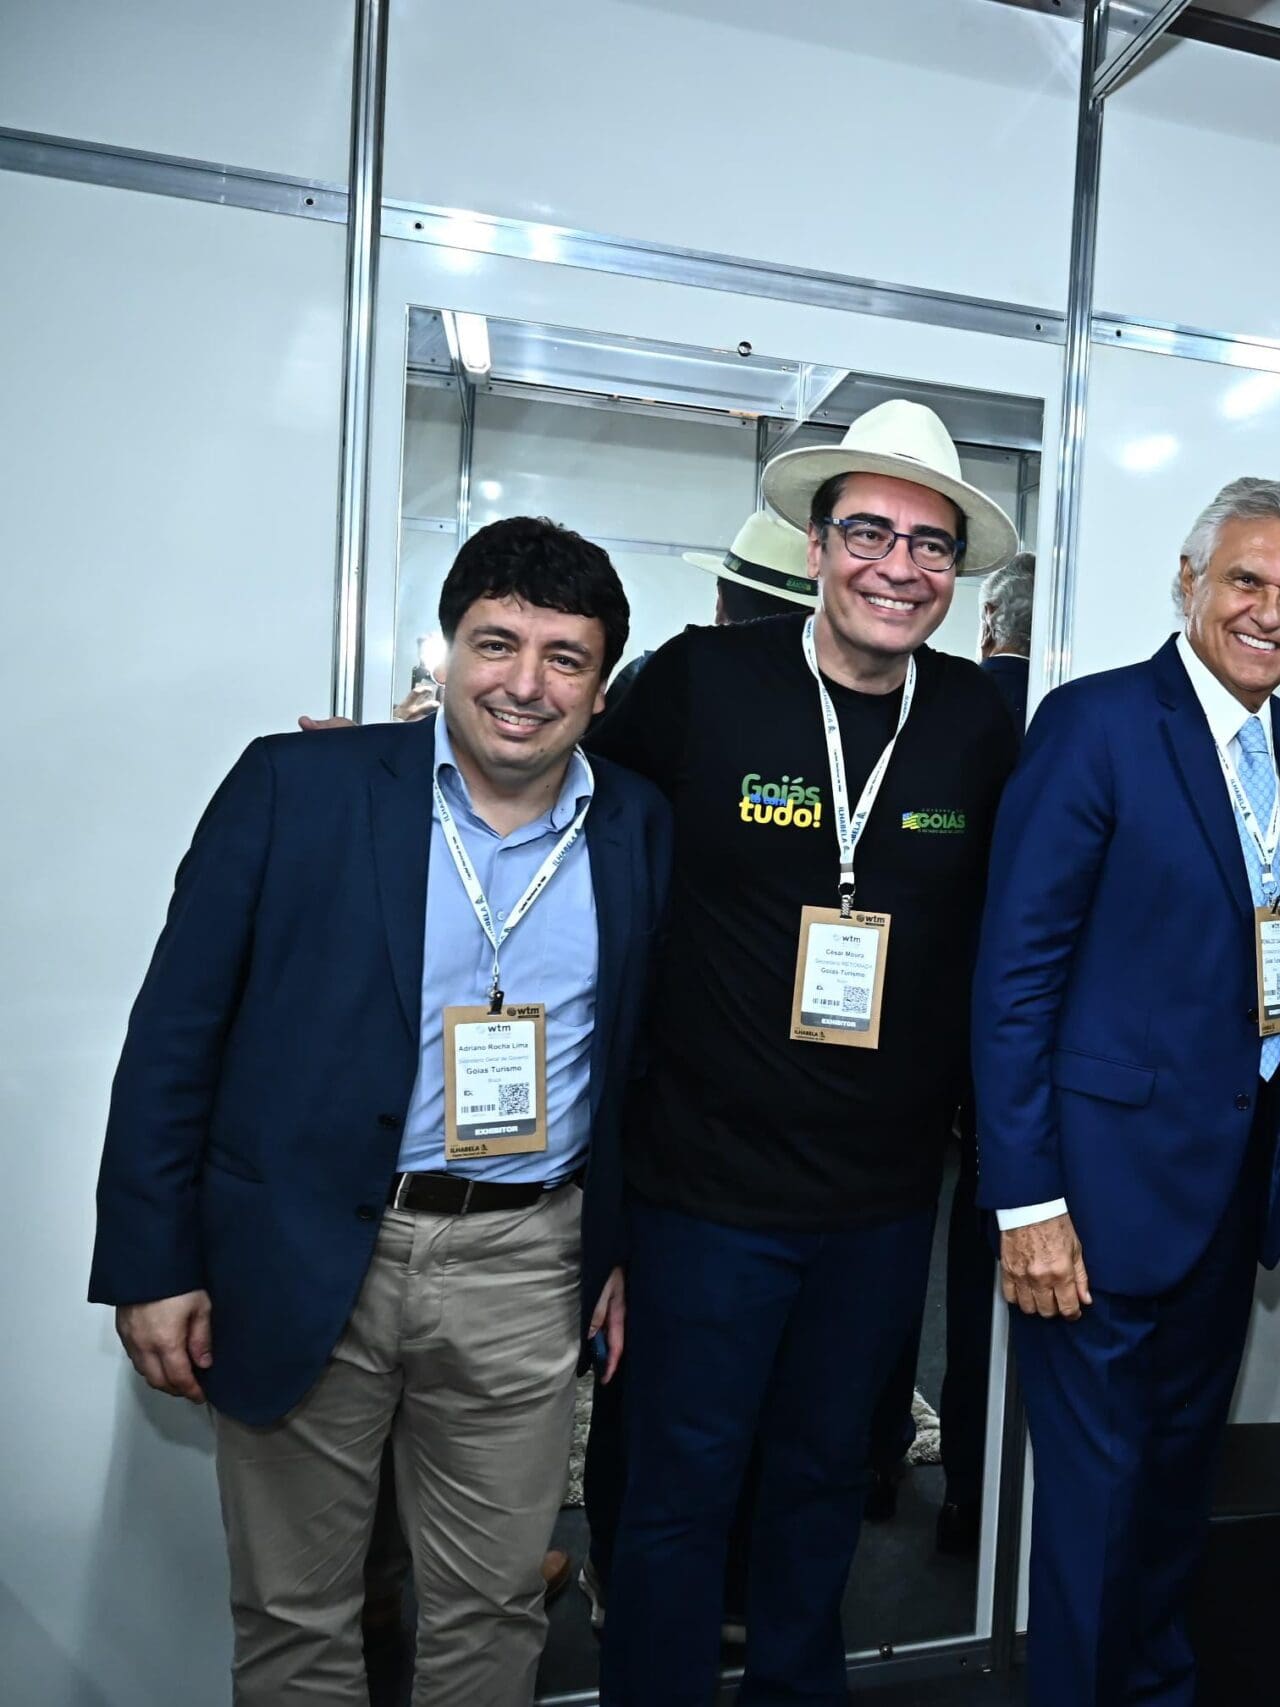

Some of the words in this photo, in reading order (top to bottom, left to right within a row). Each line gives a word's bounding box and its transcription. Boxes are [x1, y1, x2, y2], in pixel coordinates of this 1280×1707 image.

[741, 773, 821, 806] Goiás
[739, 795, 822, 828] tudo!
[916, 810, 966, 829] GOIÁS
[865, 914, 885, 923] wtm
[842, 935, 861, 943] wtm
[517, 1006, 540, 1015] wtm
[488, 1024, 511, 1033] wtm
